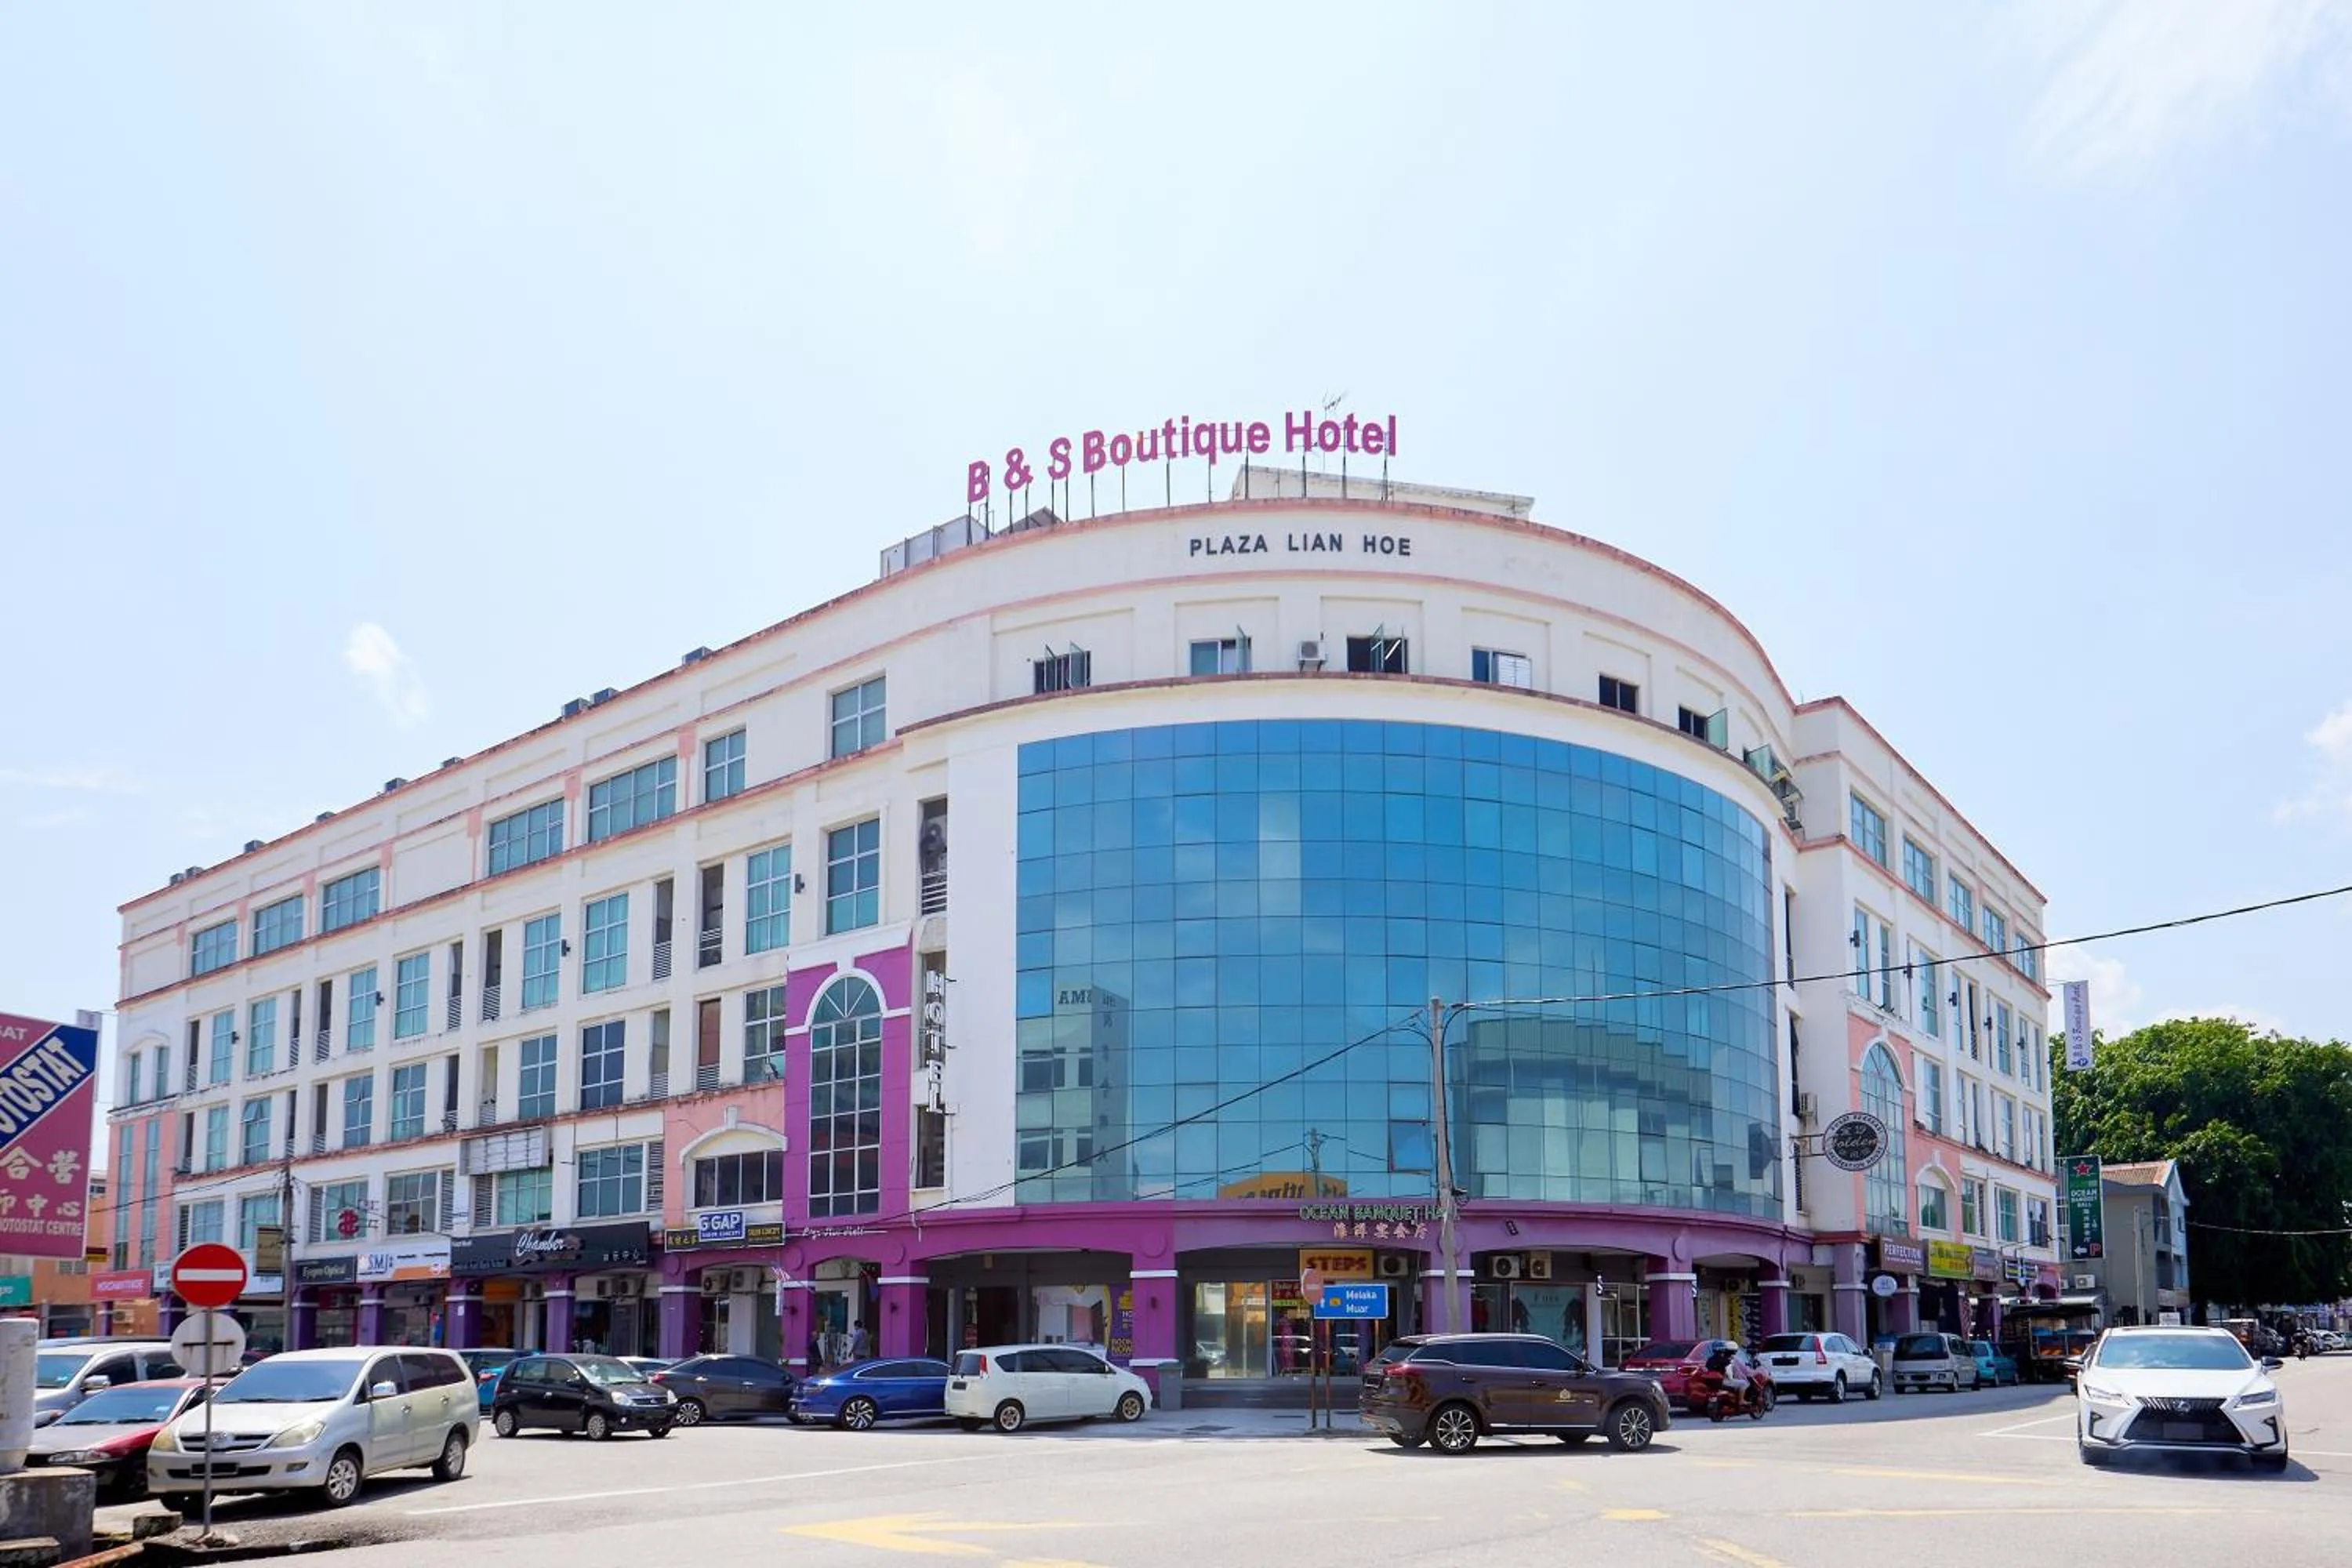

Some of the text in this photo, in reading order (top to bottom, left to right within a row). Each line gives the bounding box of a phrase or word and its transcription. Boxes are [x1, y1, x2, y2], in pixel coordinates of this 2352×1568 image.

[967, 411, 1396, 503] B & S Boutique Hotel
[1190, 533, 1410, 557] PLAZA LIAN HOE
[2071, 1188, 2097, 1196] OCEAN
[1299, 1203, 1350, 1221] OCEAN
[1354, 1203, 1420, 1221] BANQUET
[46, 1220, 83, 1236] CENTRE
[516, 1230, 565, 1257] Chamber
[2089, 1243, 2102, 1256] P
[1307, 1256, 1367, 1271] STEPS
[1346, 1290, 1377, 1300] Melaka
[1346, 1304, 1370, 1314] Muar
